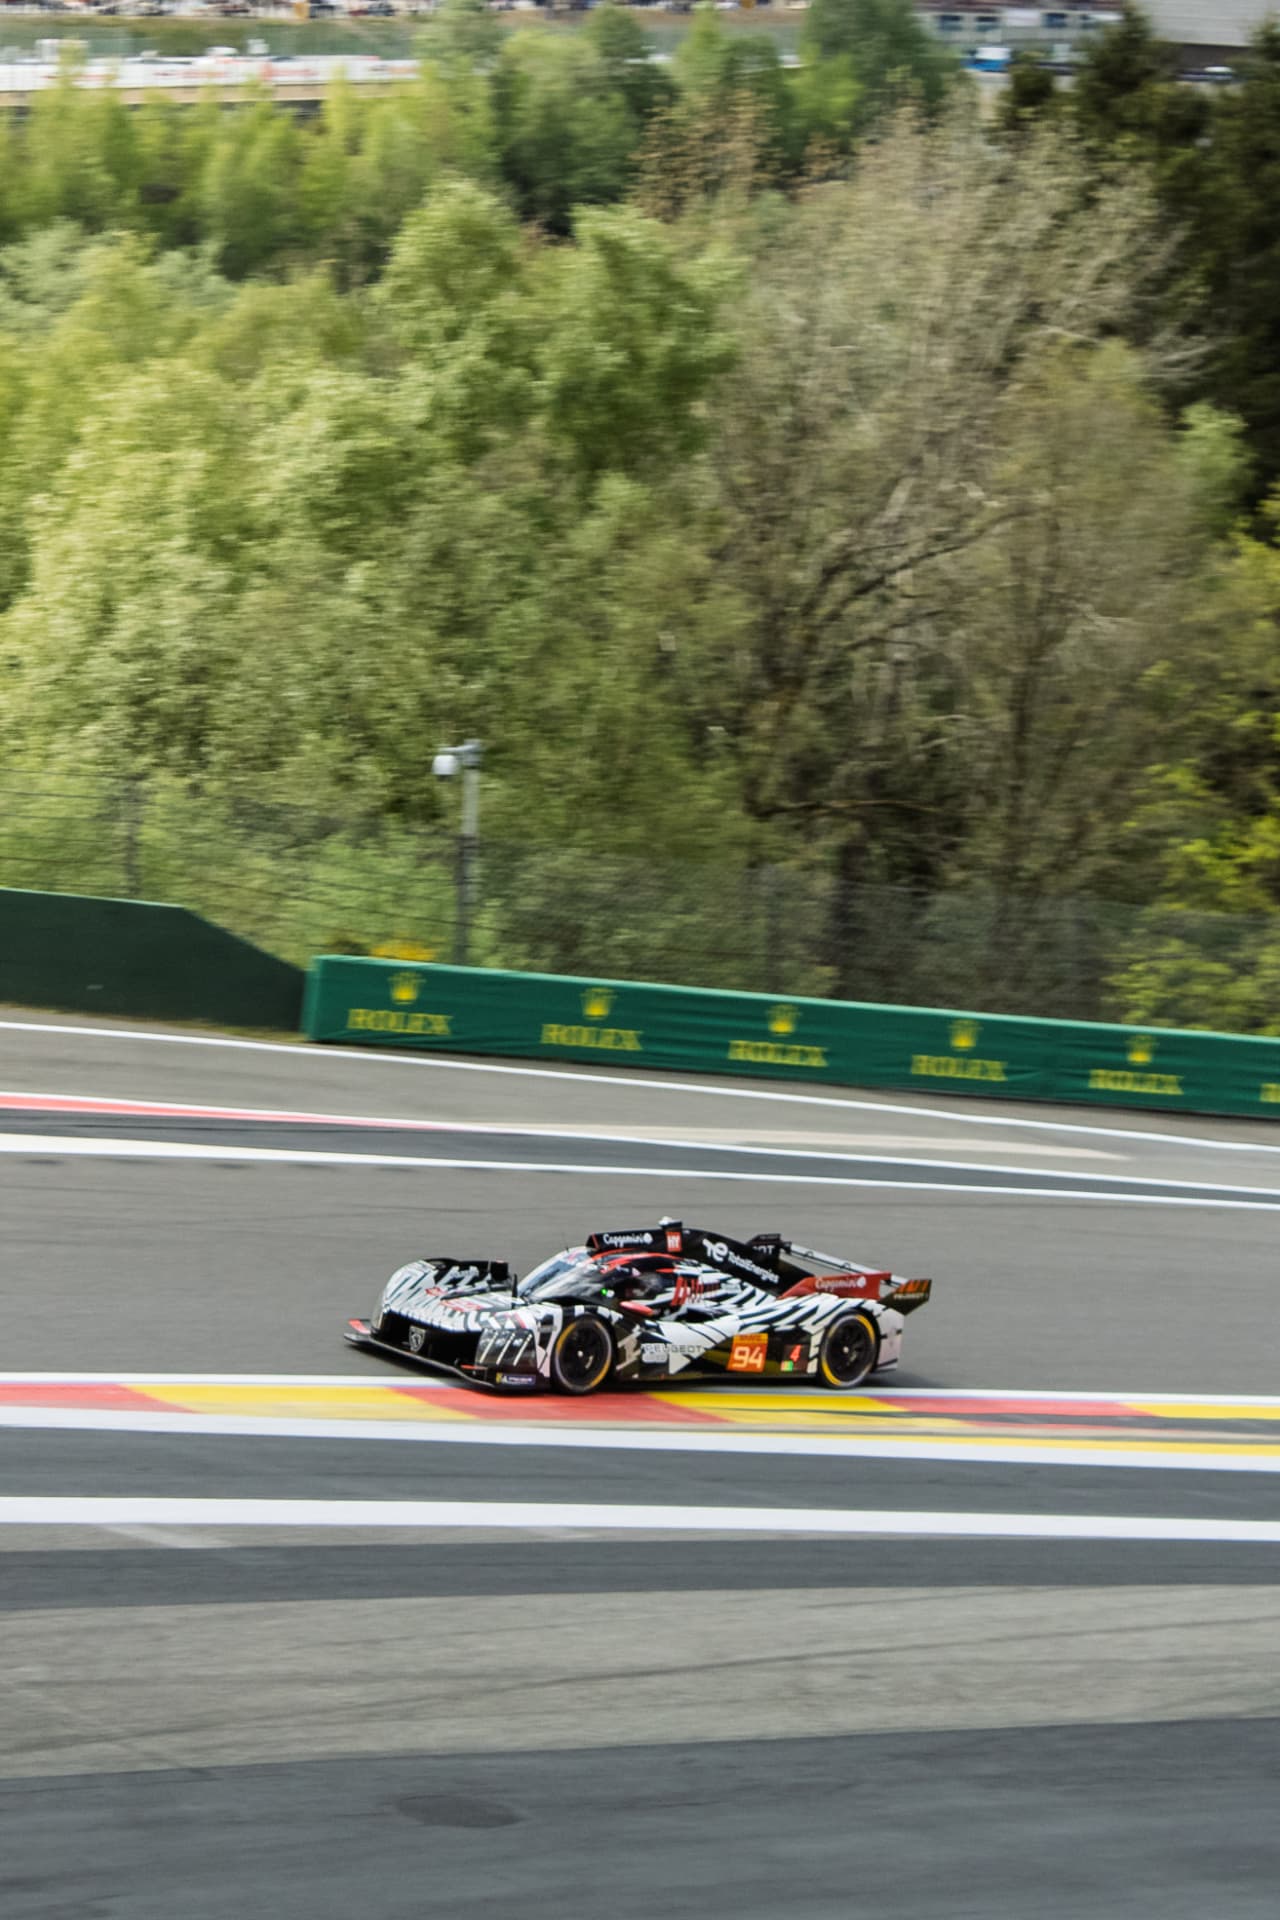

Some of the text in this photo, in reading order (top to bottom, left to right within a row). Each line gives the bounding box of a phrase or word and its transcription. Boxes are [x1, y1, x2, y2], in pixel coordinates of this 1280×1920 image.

[347, 1009, 453, 1035] ROLEX
[541, 1024, 642, 1051] ROLEX
[728, 1040, 829, 1067] ROLEX
[911, 1055, 1007, 1081] ROLEX
[1089, 1069, 1183, 1095] ROLEX
[603, 1233, 644, 1248] Capgemini
[728, 1251, 779, 1284] TotalEnergies
[644, 1344, 702, 1354] PEUGEOT
[732, 1346, 764, 1369] 94
[789, 1344, 802, 1363] 4
